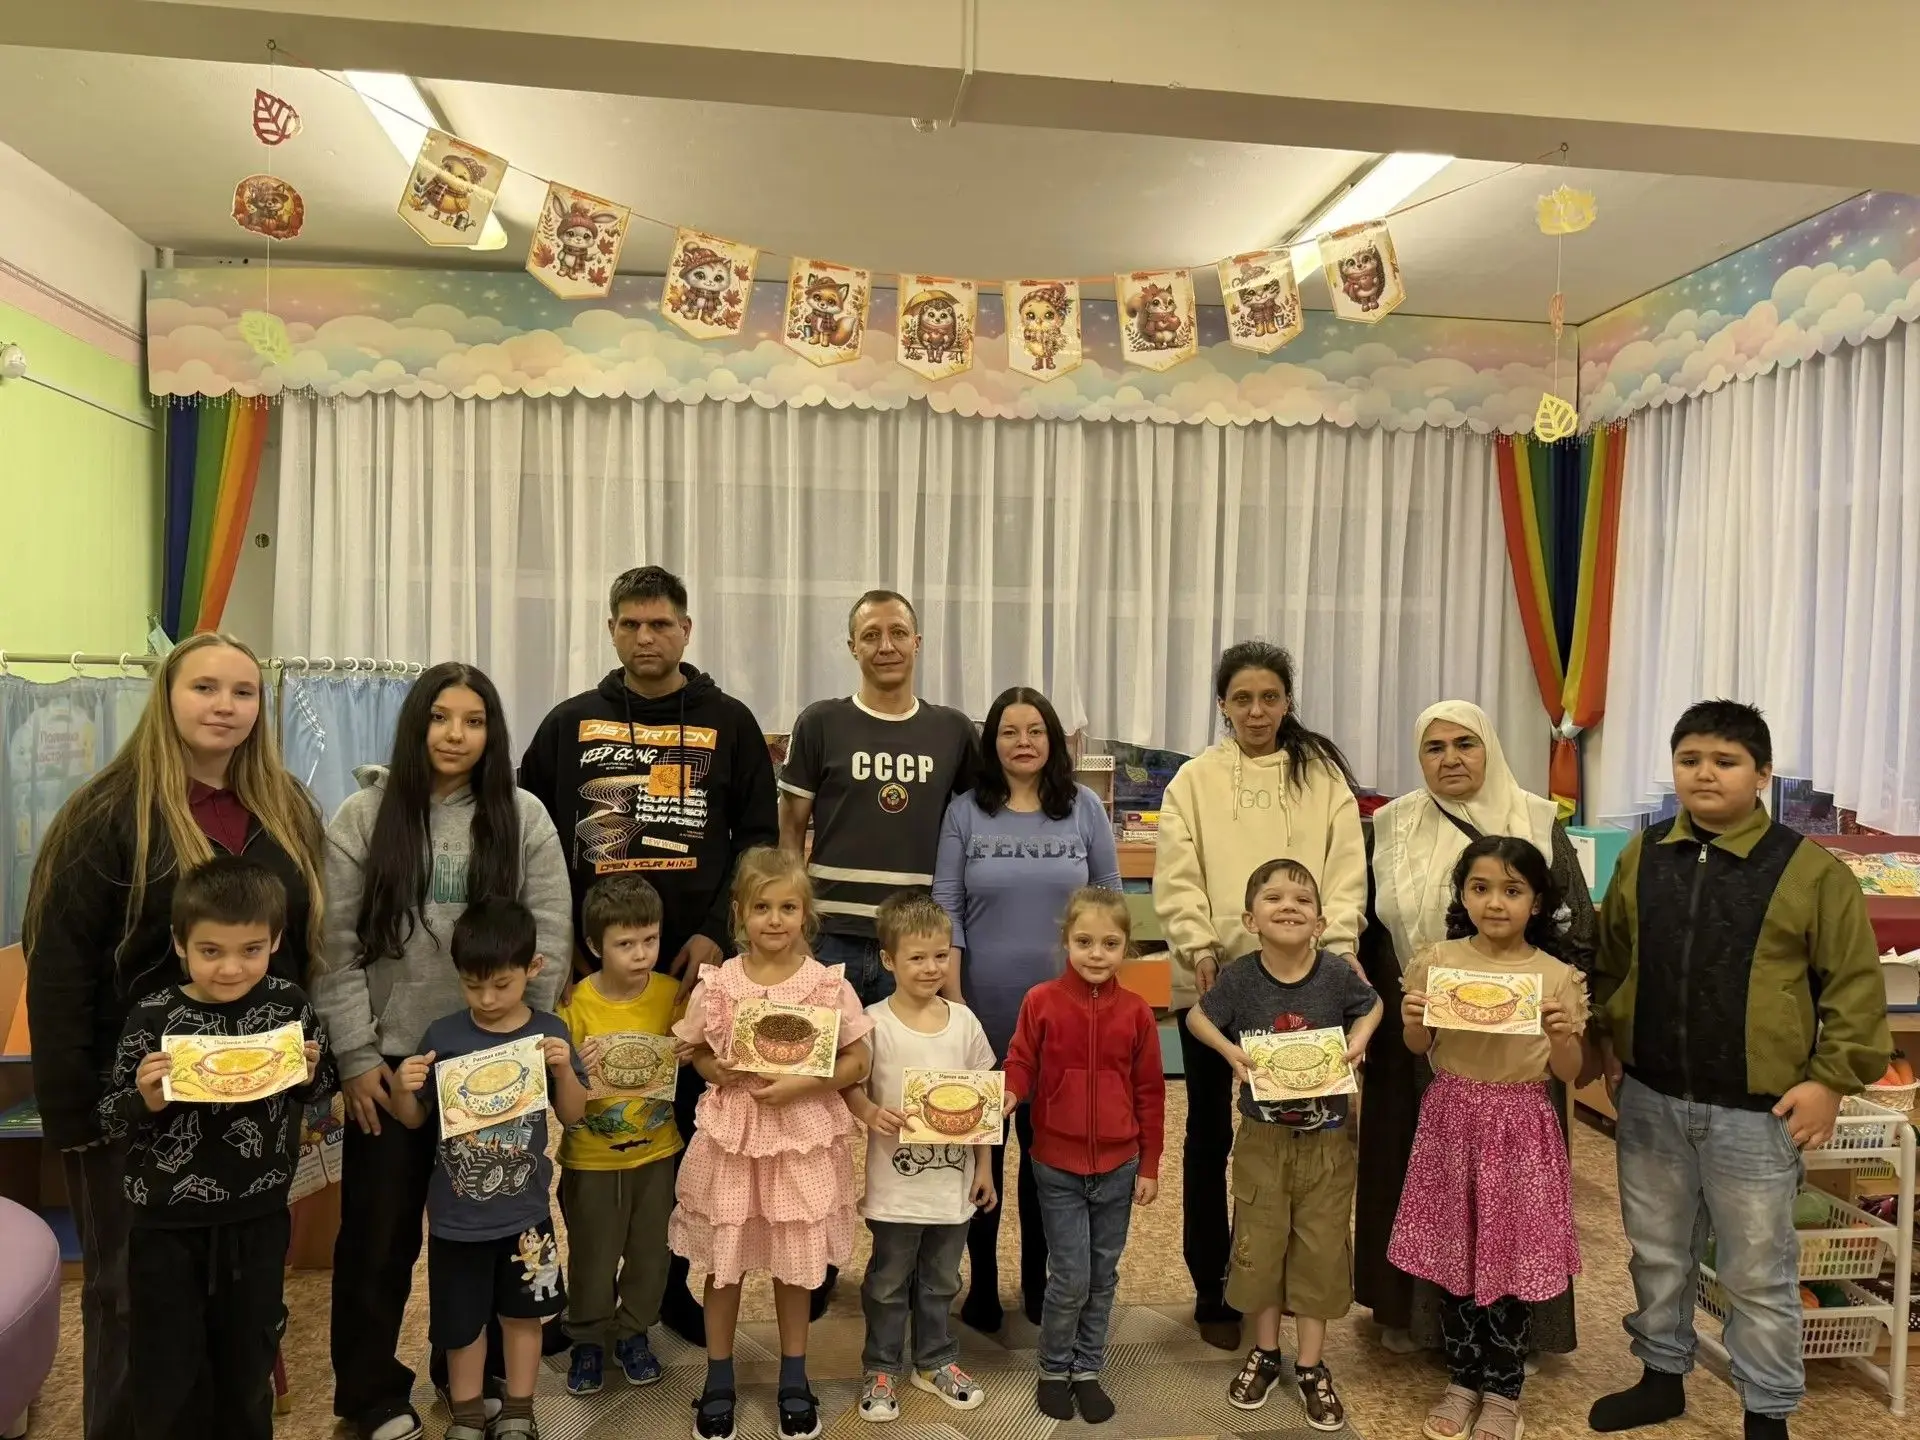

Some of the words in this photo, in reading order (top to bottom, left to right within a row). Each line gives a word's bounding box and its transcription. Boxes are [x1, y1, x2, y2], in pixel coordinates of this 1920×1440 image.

[580, 746, 614, 768] KEEP
[852, 751, 934, 783] СССР
[637, 793, 669, 804] YOUR
[1240, 789, 1271, 809] GO
[636, 803, 669, 813] YOUR
[635, 813, 668, 823] YOUR
[668, 816, 708, 828] POISON
[661, 840, 688, 851] WORLD
[967, 834, 1084, 860] FENDI
[600, 862, 629, 871] OPEN
[633, 860, 663, 869] YOUR
[666, 860, 693, 868] MIND
